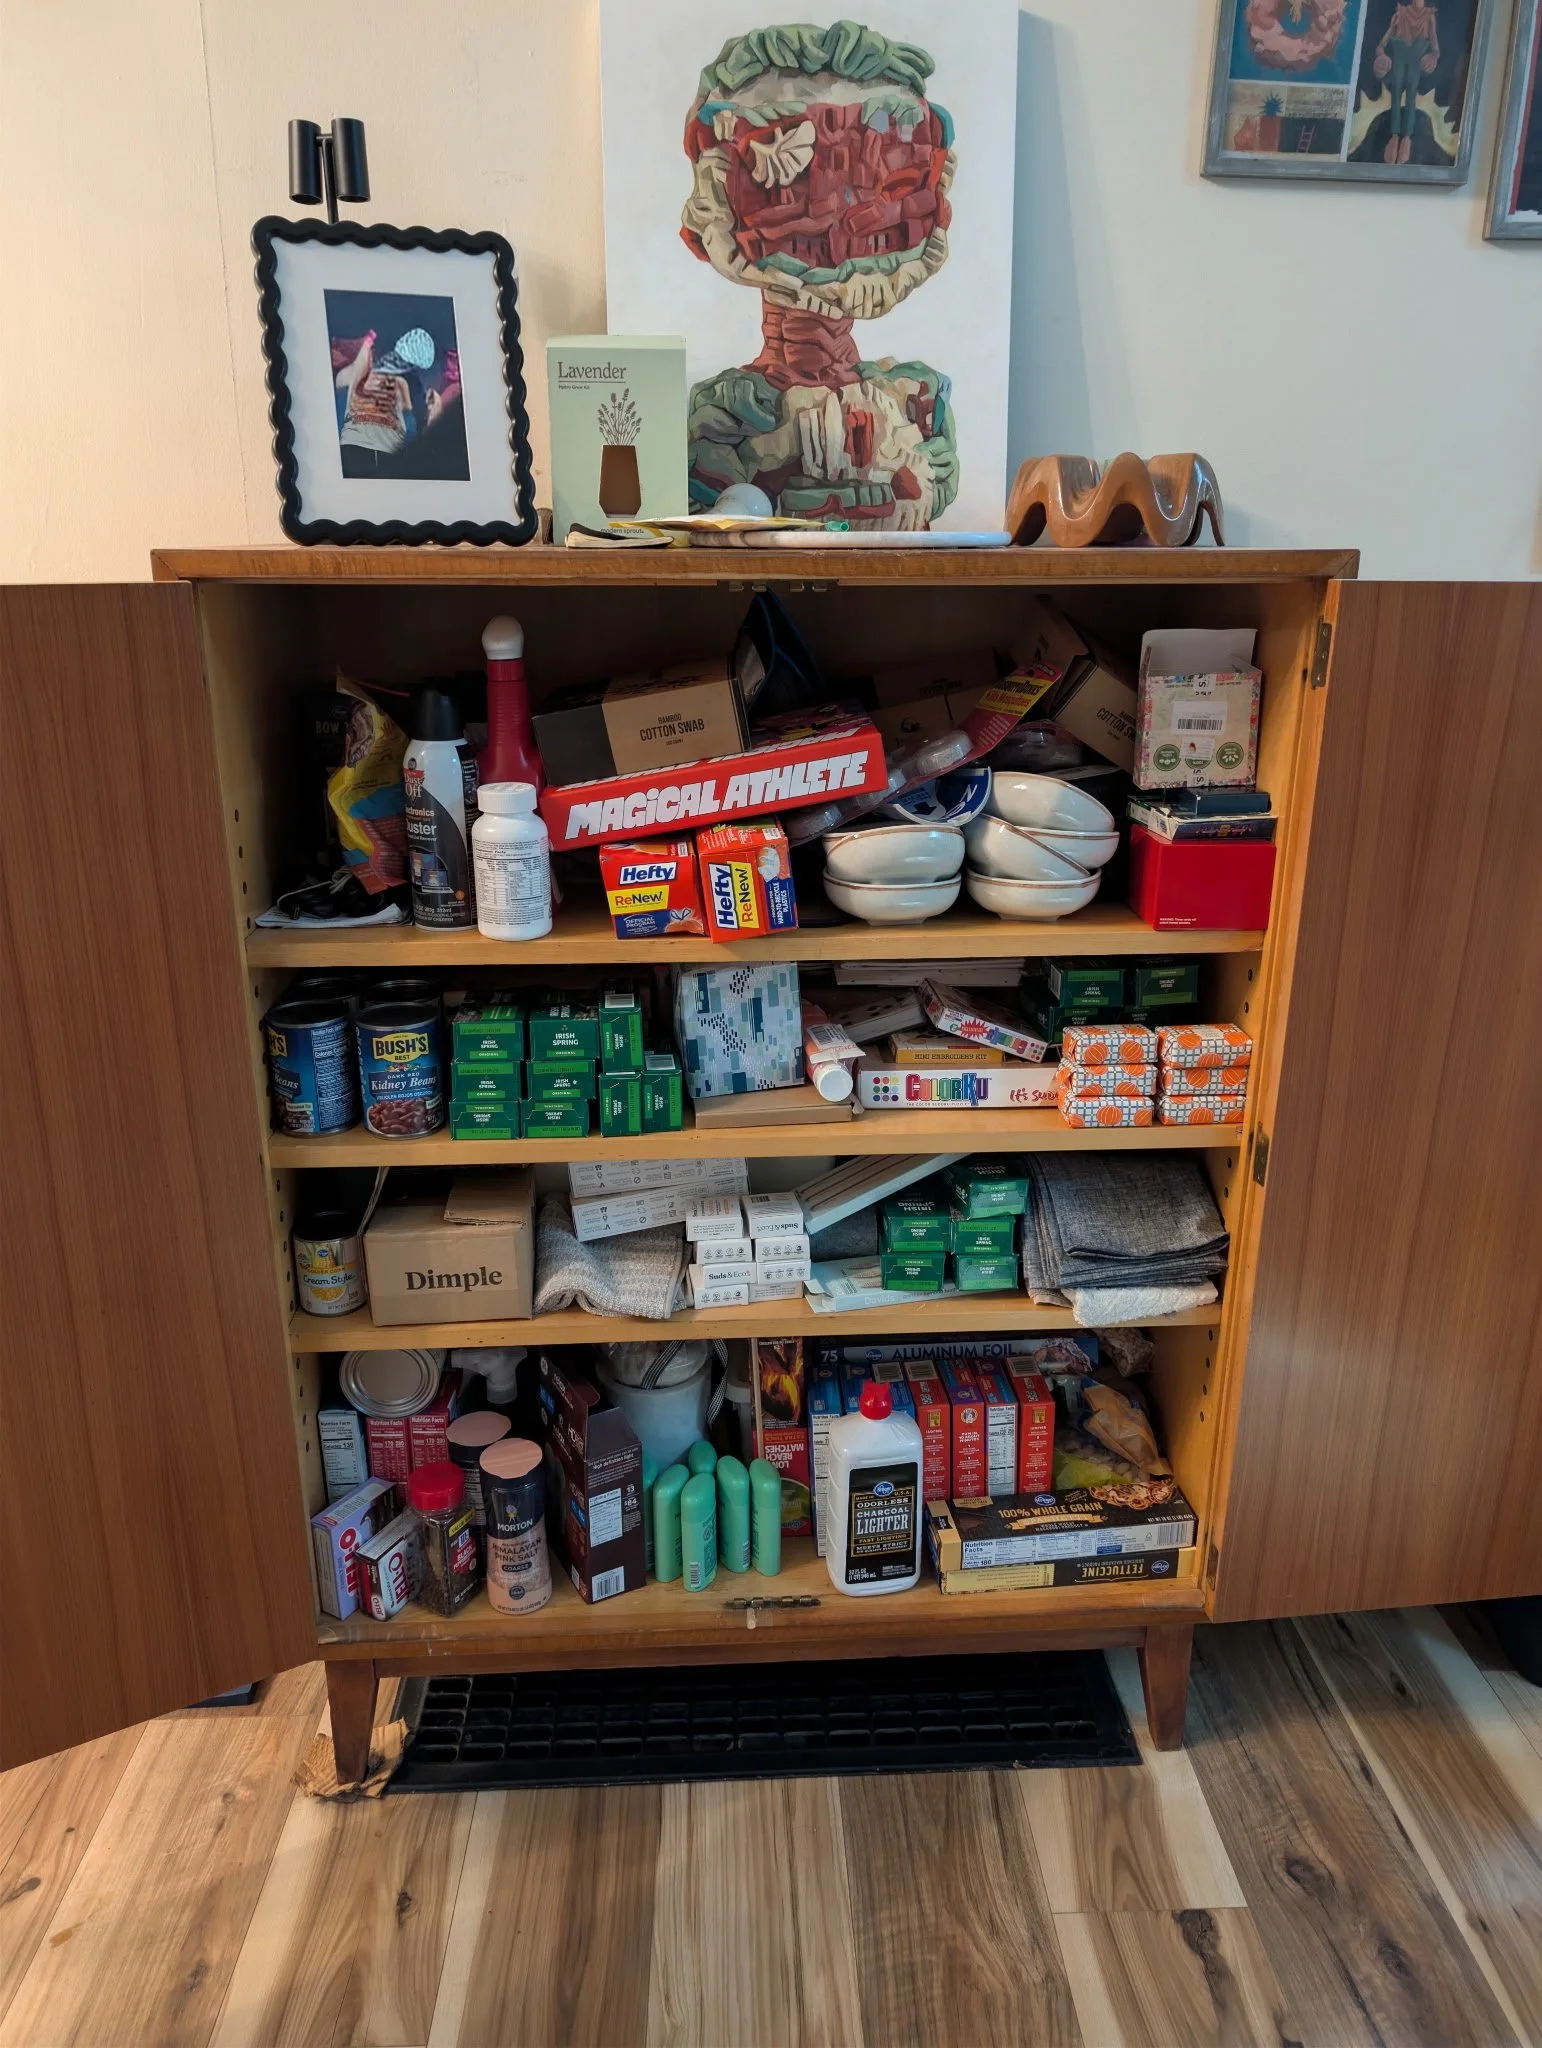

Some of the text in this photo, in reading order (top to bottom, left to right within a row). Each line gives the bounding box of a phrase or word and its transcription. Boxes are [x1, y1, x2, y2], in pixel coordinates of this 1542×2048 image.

[558, 362, 626, 379] Lavender
[658, 713, 681, 724] BAMBOO
[1096, 708, 1127, 732] COTTON
[315, 720, 340, 734] BOW
[640, 718, 704, 741] COTTON SWAB
[722, 750, 868, 811] ATHLETE
[405, 783, 422, 798] Off
[623, 866, 673, 882] Hefty
[615, 891, 662, 906] ReNew
[715, 867, 735, 925] Hefty
[735, 868, 753, 922] ReNew
[773, 881, 784, 924] HARD-TO-RECYCLE
[376, 1036, 427, 1056] BUSH'S
[274, 1072, 298, 1089] Beans
[371, 1076, 436, 1092] Kidney Beans
[1010, 1088, 1028, 1102] It's
[304, 1273, 352, 1284] Cream Style
[405, 1266, 503, 1292] Dimple
[821, 1351, 838, 1362] 75
[864, 1344, 1014, 1361] Kroger ALUMINUM FOIL
[764, 1443, 804, 1453] MATCHES
[603, 1457, 624, 1467] definition
[765, 1451, 793, 1462] REACH
[776, 1459, 789, 1469] LON
[877, 1484, 892, 1494] Kroger
[857, 1498, 909, 1508] ODORLESS
[1036, 1496, 1054, 1504] Kroger
[857, 1507, 910, 1518] CHARCOAL
[998, 1502, 1103, 1518] 100% WHOLE GRAIN
[497, 1519, 533, 1532] MORTON
[857, 1514, 908, 1535] LIGHTER
[458, 1545, 473, 1561] BLACK
[492, 1537, 542, 1554] HIMALAYAN
[495, 1548, 538, 1563] PINK SALT
[1082, 1564, 1143, 1578] FETTUCCINE
